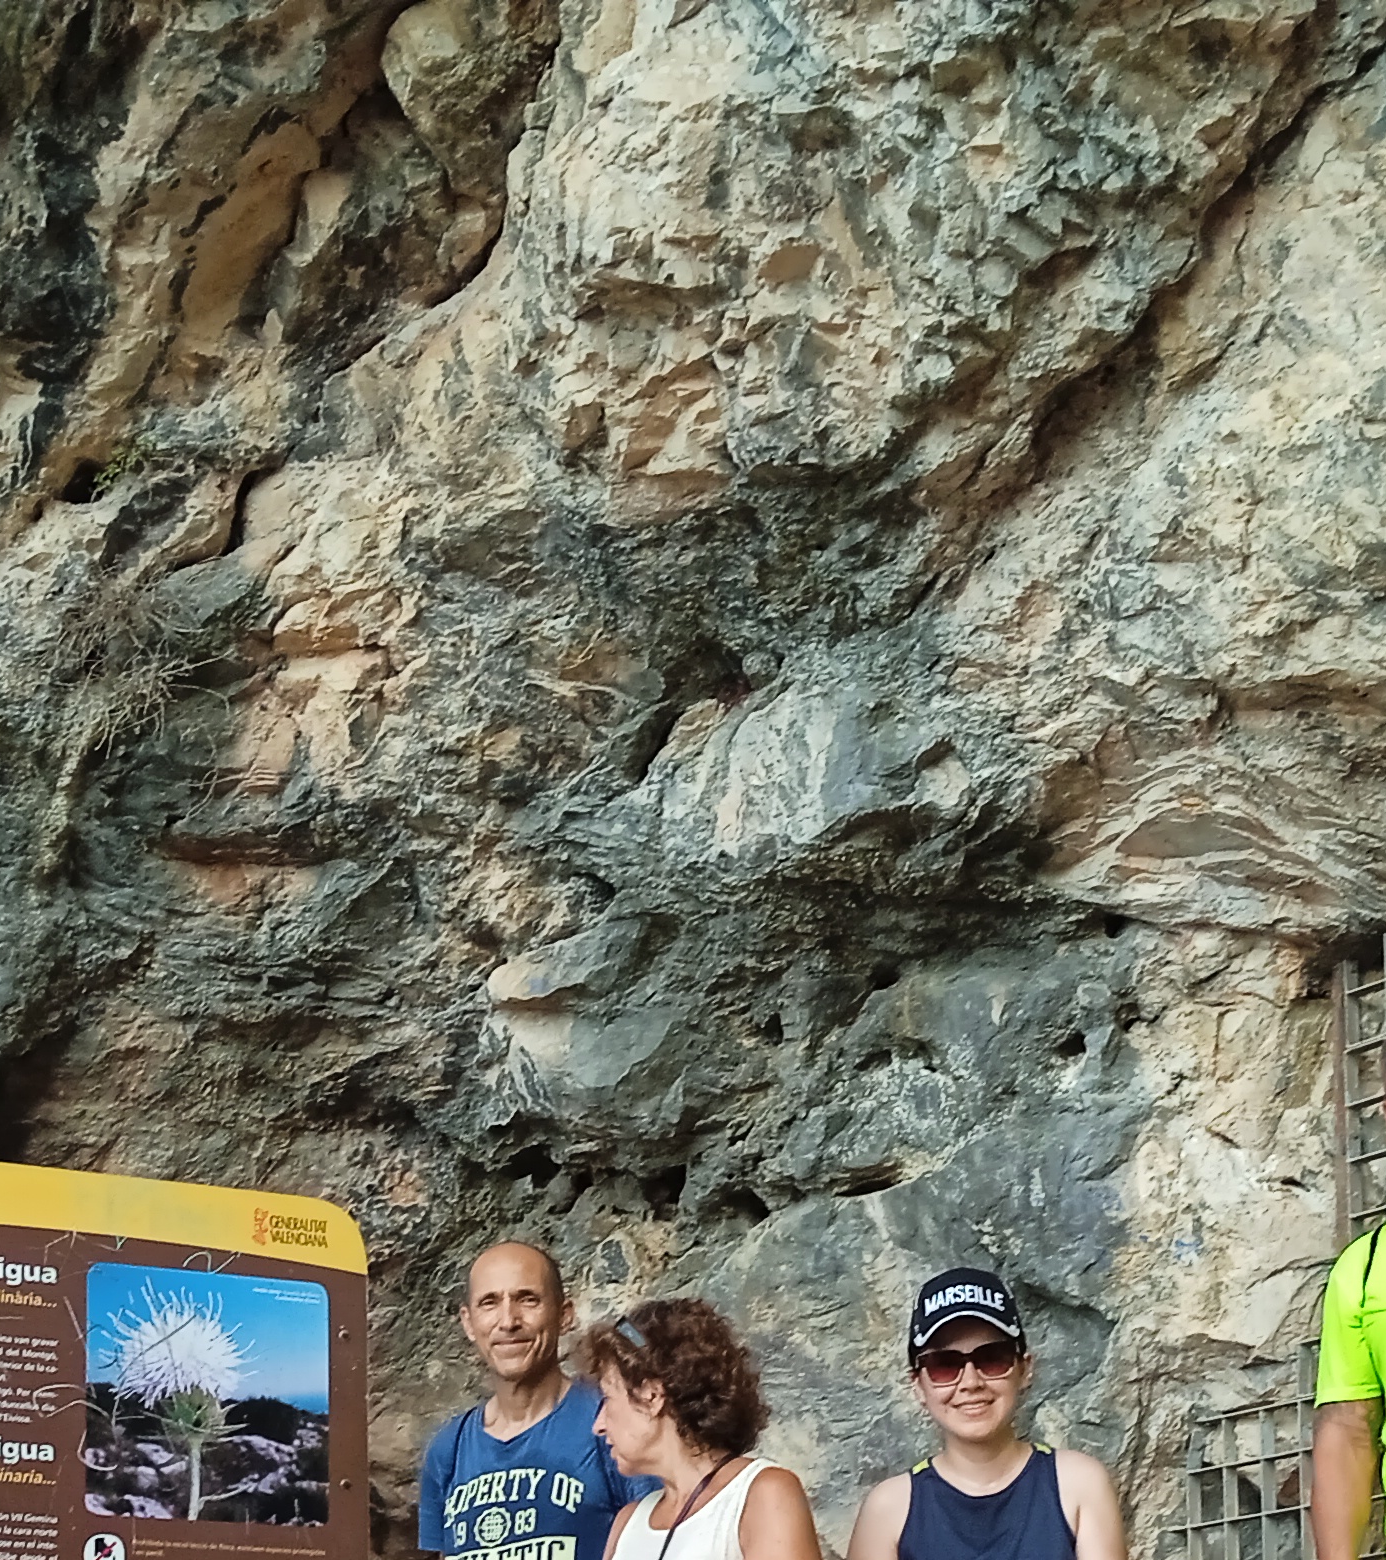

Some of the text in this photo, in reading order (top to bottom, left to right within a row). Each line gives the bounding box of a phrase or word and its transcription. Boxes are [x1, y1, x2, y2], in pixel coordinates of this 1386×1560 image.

[269, 1215, 328, 1233] GENERALITAT
[270, 1230, 328, 1248] VALENCIANA
[924, 1285, 1005, 1316] MARSEILLE
[444, 1468, 584, 1528] ROPERTY OF
[515, 1507, 537, 1536] 83
